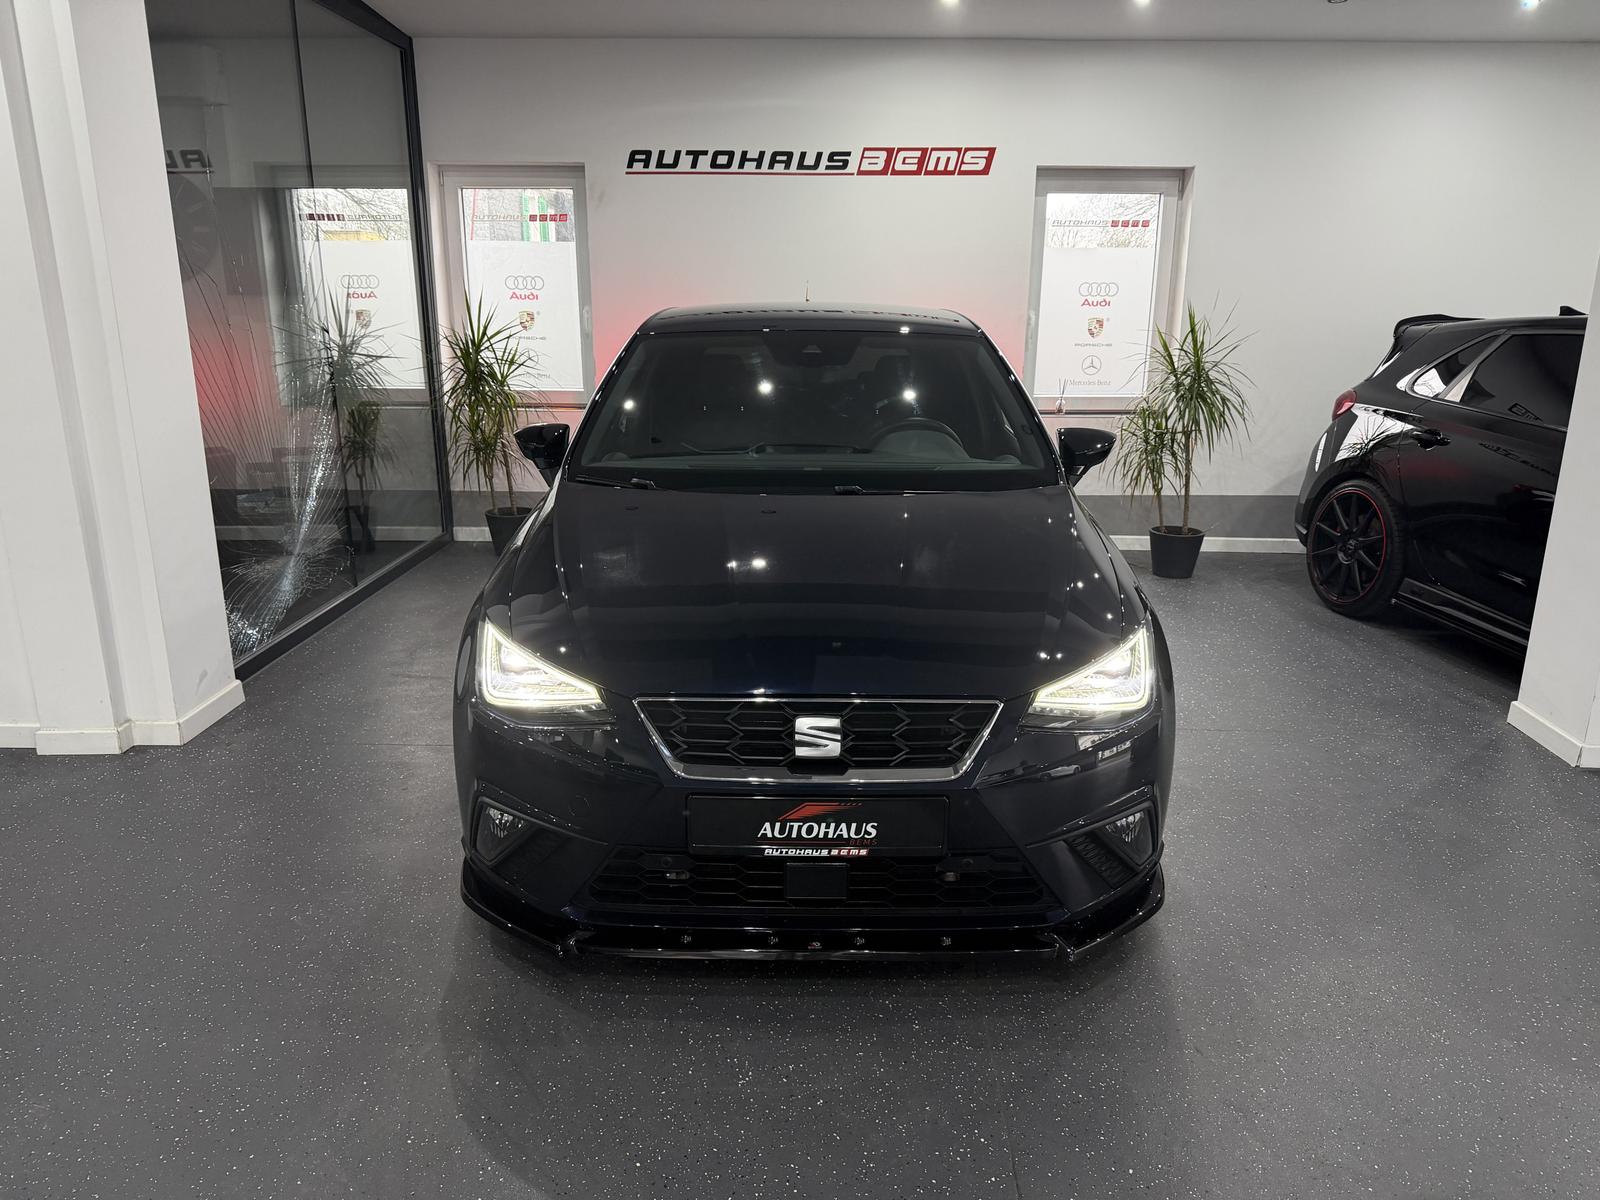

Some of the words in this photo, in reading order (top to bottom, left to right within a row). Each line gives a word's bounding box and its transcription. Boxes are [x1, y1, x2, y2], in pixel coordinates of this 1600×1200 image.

[626, 149, 852, 171] AUTOHAUS
[857, 148, 994, 174] BEMS
[509, 291, 539, 300] Audi
[1080, 298, 1111, 307] Audi
[757, 822, 878, 838] AUTOHAUS
